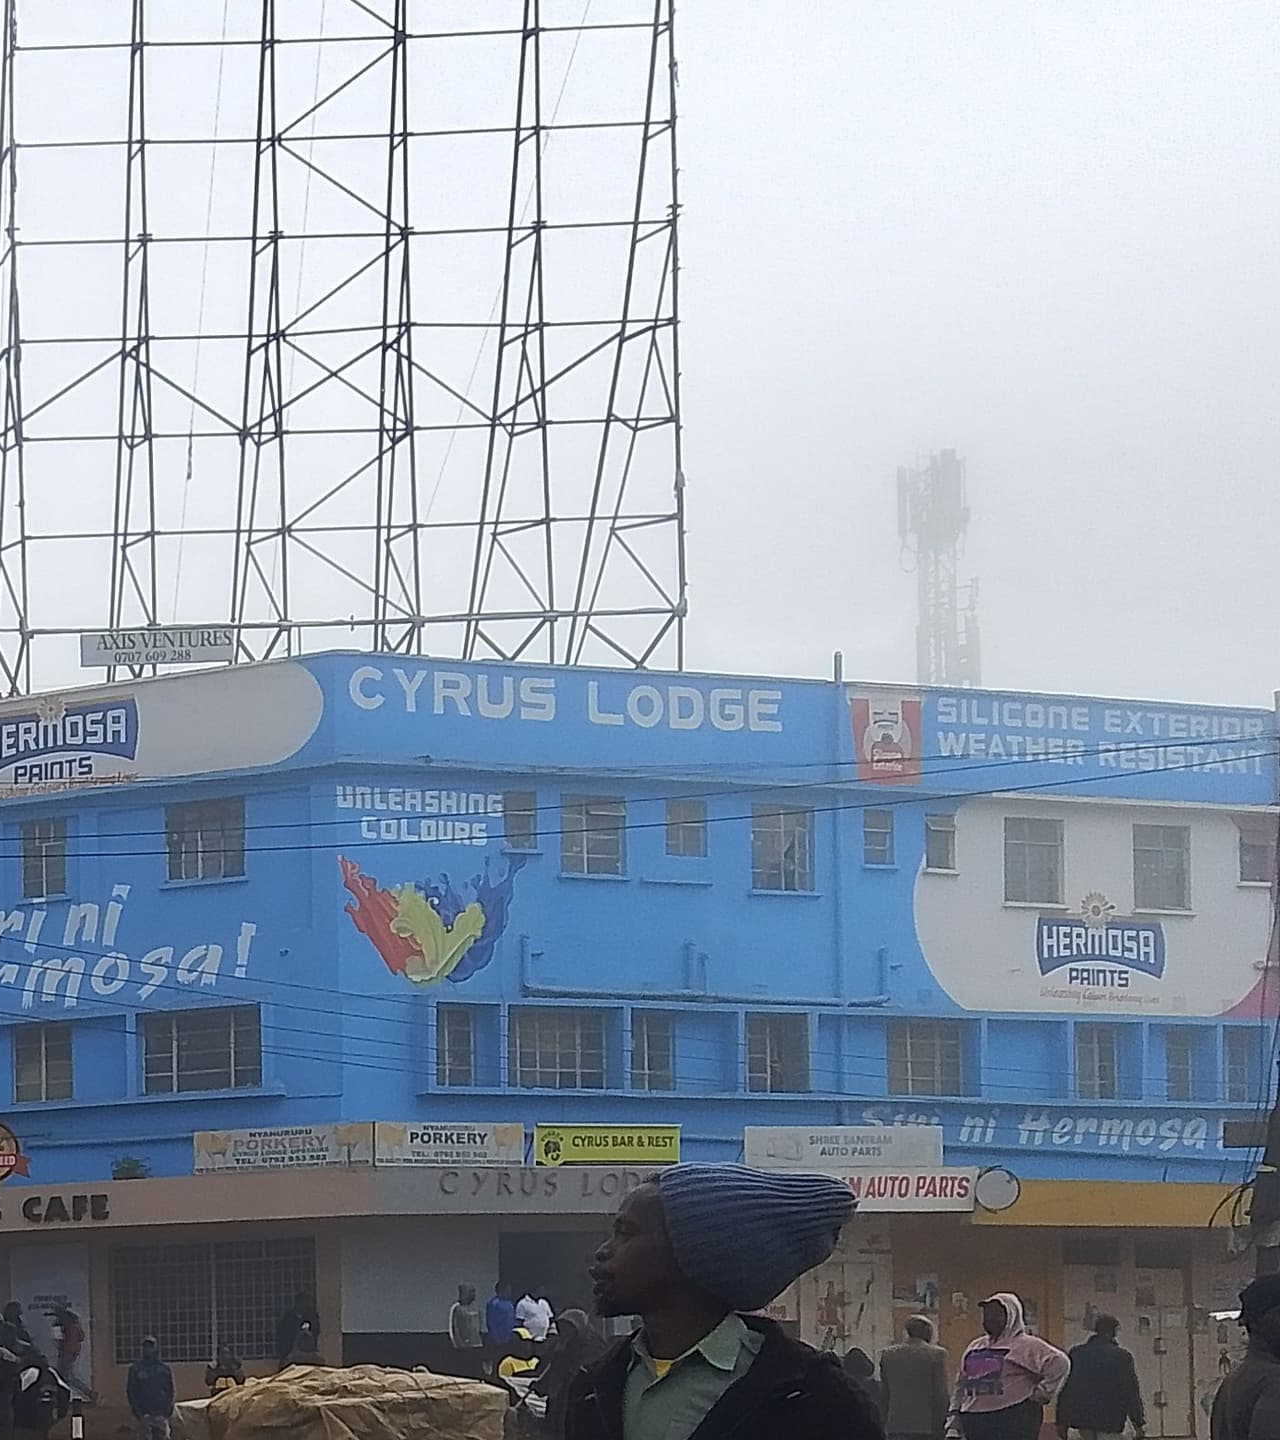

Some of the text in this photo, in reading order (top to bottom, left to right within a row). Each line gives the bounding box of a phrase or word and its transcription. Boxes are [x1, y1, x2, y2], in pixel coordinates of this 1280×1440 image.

[97, 630, 232, 650] AXIS VENTURES
[114, 649, 192, 664] 0707 609 288
[349, 666, 783, 732] CYRUS LODGE
[937, 697, 1265, 740] SILICONE EXTERIOR
[937, 731, 1087, 766] WEATHER
[1098, 740, 1265, 776] RESISTANT
[13, 756, 93, 785] PAINTS
[335, 784, 504, 818] UNLEASHING
[360, 816, 488, 847] COLOURS
[62, 884, 133, 947] ni
[1041, 924, 1156, 964] HERMOSA
[1068, 967, 1130, 988] PAINTS
[409, 1132, 488, 1144] PORKERY
[959, 1106, 1000, 1144] ni
[233, 1135, 327, 1151] PORKERY
[572, 1135, 608, 1148] CYRUS
[612, 1136, 634, 1147] BAR
[637, 1136, 646, 1147] &
[648, 1136, 674, 1148] REST
[820, 1147, 882, 1157] AUTO PARTS
[439, 1170, 559, 1197] CYRUS
[865, 1176, 911, 1199] AUTO
[915, 1176, 970, 1199] PARTS
[22, 1194, 110, 1222] CAFE
